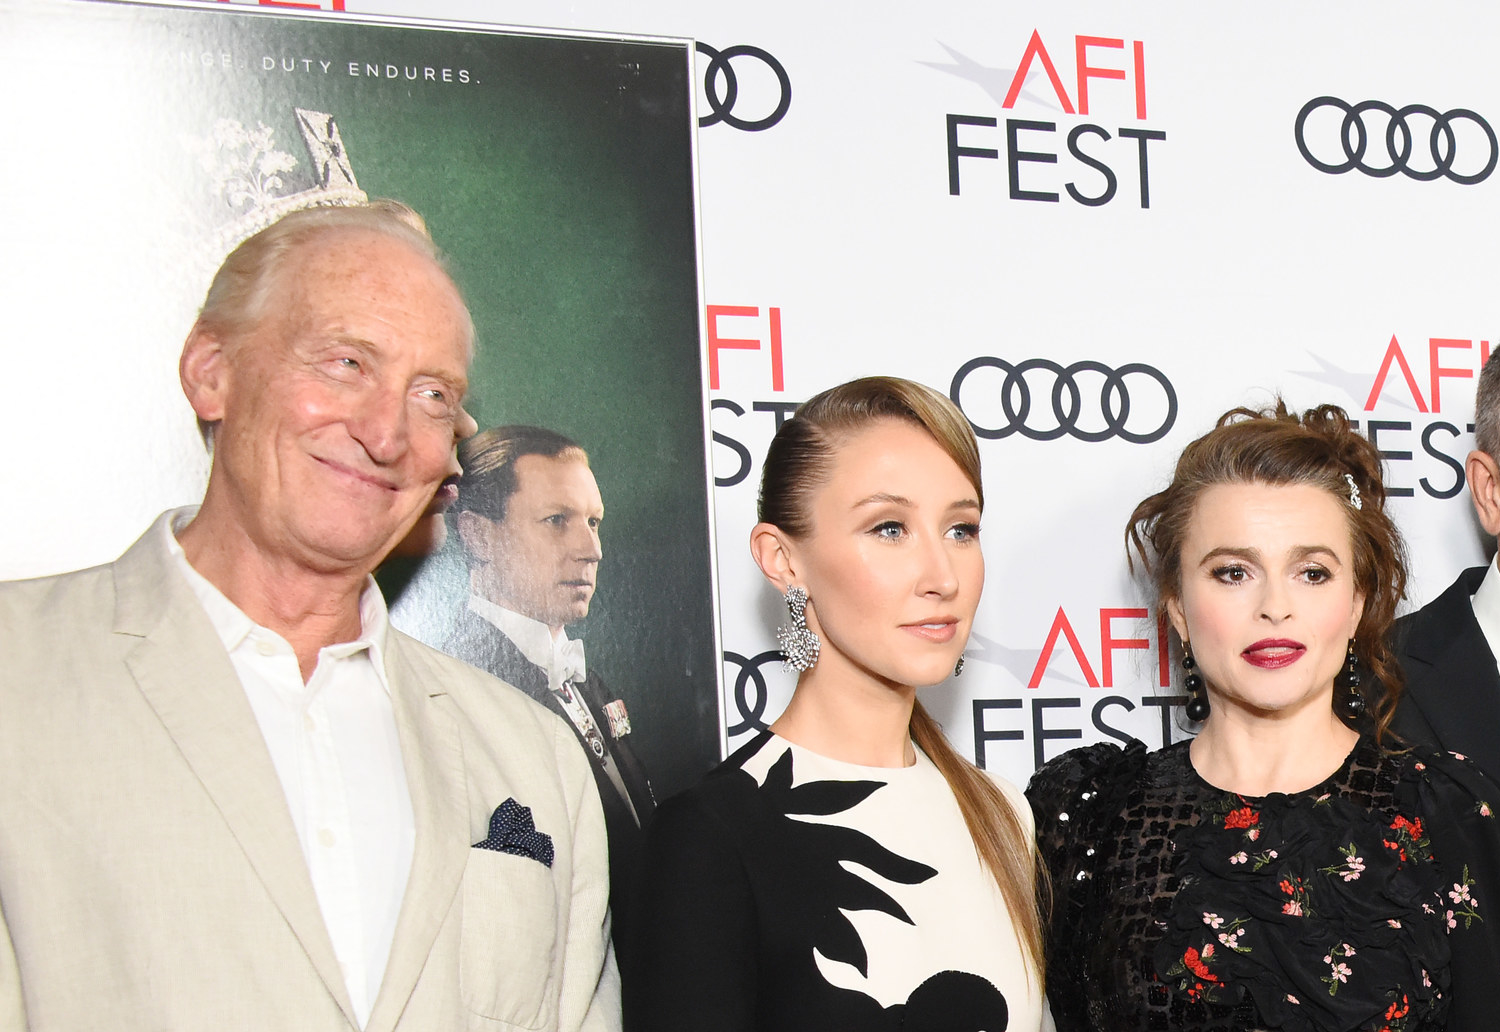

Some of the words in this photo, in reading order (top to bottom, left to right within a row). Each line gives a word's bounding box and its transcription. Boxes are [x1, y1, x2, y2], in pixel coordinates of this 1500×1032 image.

[263, 57, 331, 74] DUTY
[349, 62, 481, 84] ENDURES.
[1002, 28, 1147, 120] AFI
[946, 114, 1166, 209] FEST
[706, 305, 784, 392] FI
[1027, 605, 1170, 688] AFI
